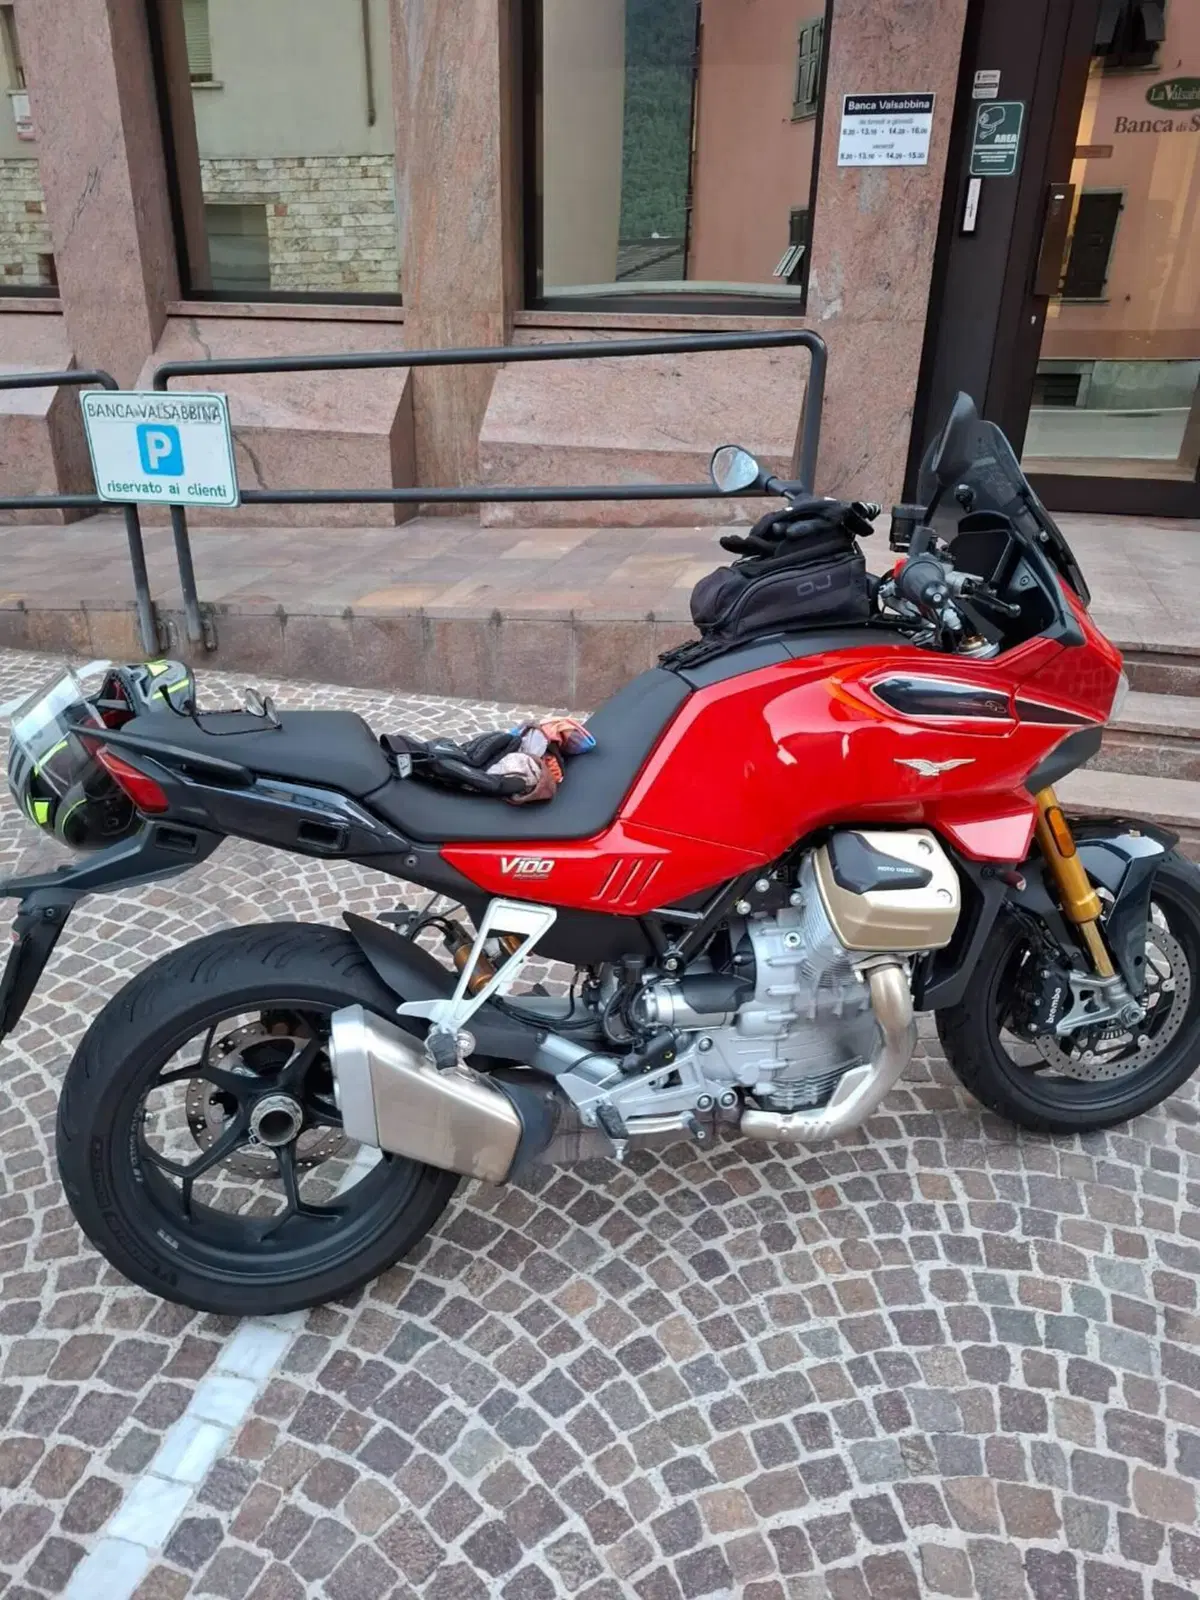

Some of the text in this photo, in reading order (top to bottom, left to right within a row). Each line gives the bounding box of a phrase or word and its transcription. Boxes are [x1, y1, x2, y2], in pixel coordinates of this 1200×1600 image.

[848, 100, 930, 110] Banca Valsabbina
[1113, 116, 1173, 133] Banca
[994, 134, 1017, 143] AREA
[87, 403, 221, 422] BANCA VALSABBINA
[146, 431, 172, 469] P
[107, 480, 226, 497] riservato ai clienti
[501, 856, 555, 874] V100
[1045, 987, 1062, 1024] brembo
